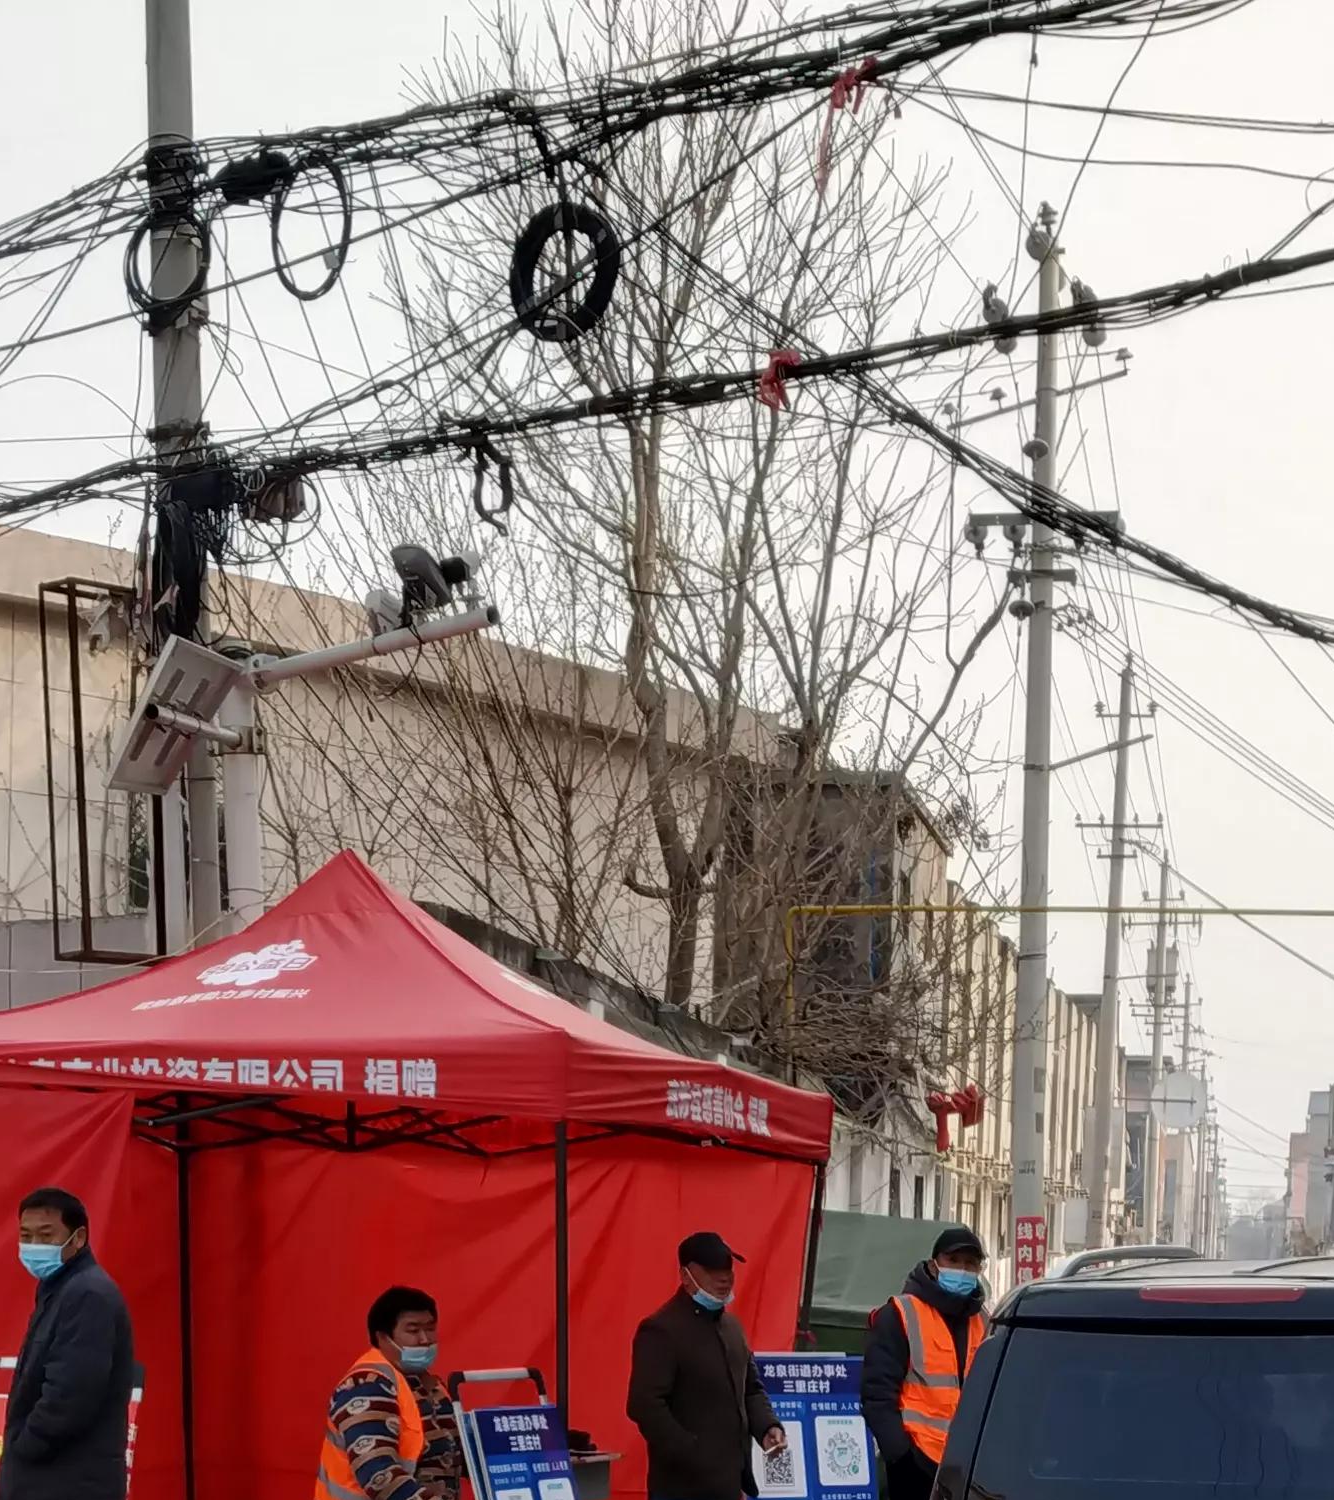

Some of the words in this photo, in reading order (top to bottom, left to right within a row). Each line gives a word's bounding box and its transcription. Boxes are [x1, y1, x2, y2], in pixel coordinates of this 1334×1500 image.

[364, 1058, 437, 1098] 捐赠
[763, 1364, 848, 1378] 龙泉街道办事处
[783, 1380, 831, 1394] 三里庄村
